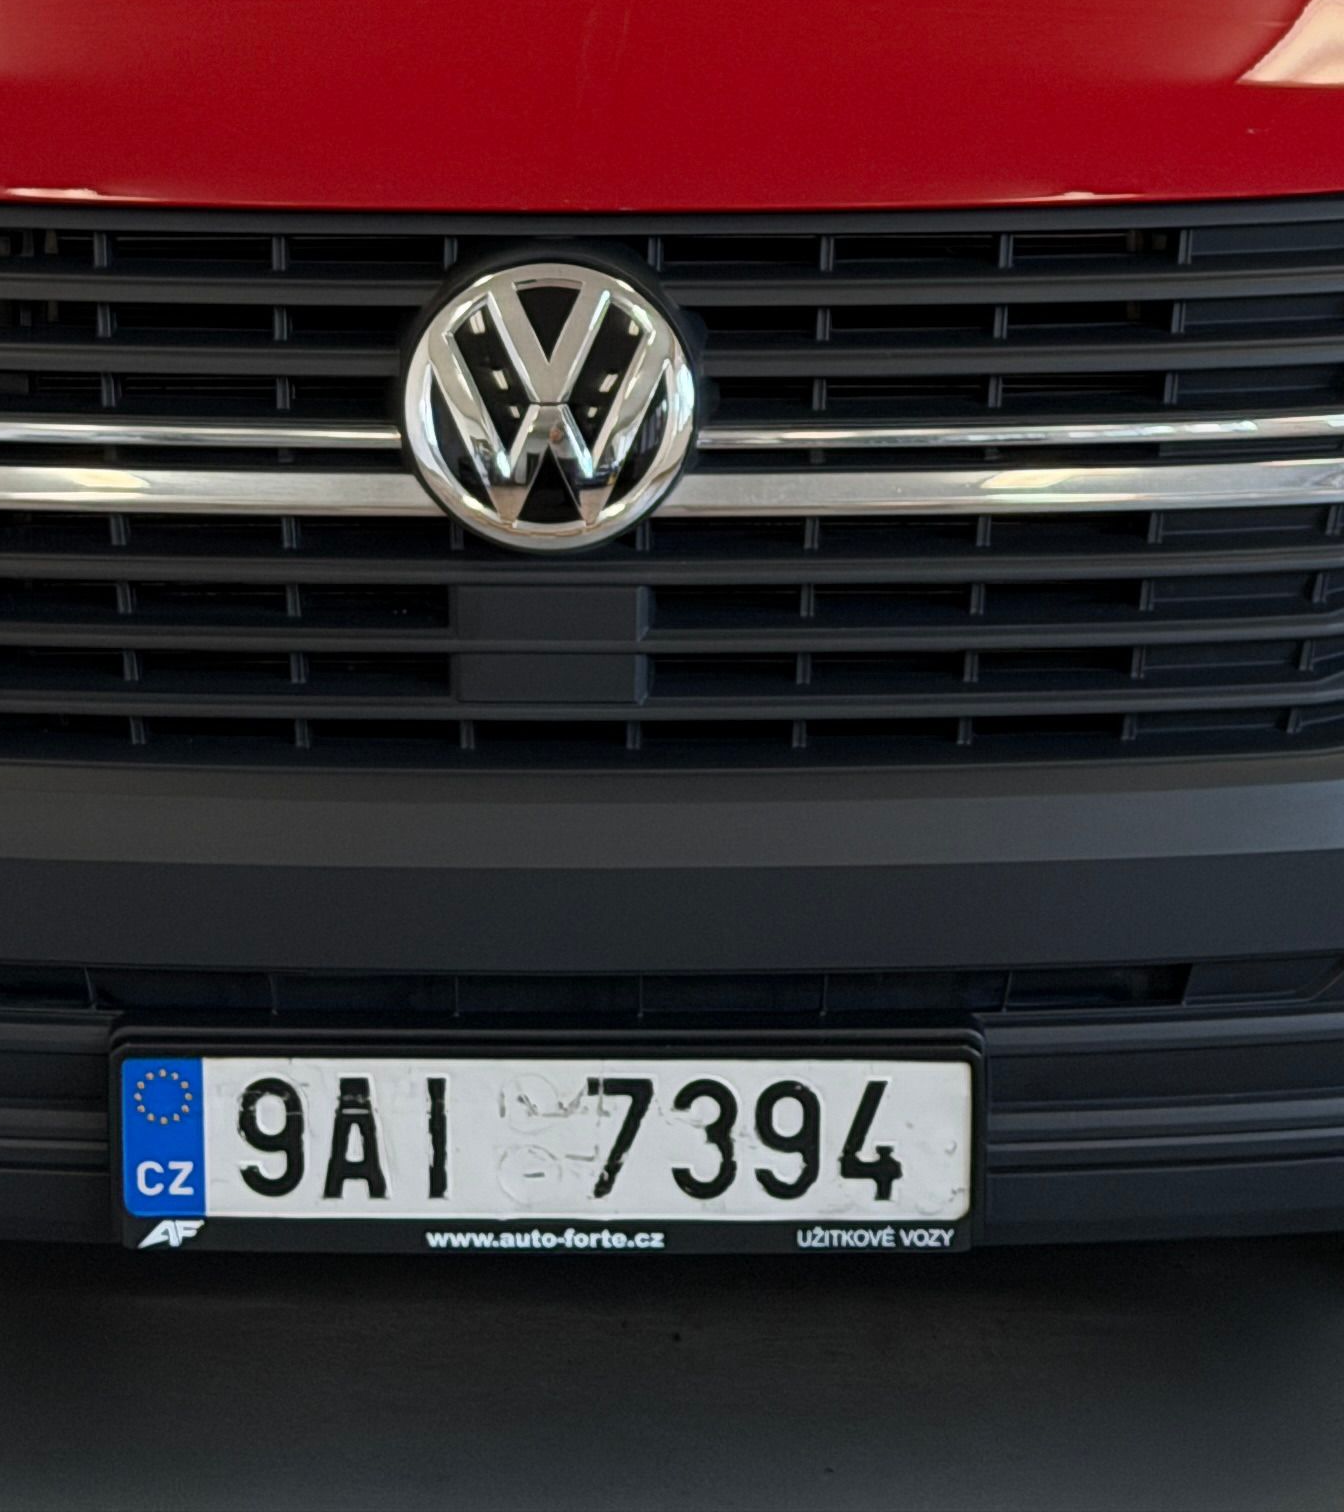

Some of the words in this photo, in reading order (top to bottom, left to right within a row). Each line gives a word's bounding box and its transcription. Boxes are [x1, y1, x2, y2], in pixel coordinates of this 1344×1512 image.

[587, 1078, 903, 1201] 7394
[136, 1161, 194, 1196] CZ
[426, 1228, 665, 1249] www.auto-forte.cz
[797, 1226, 896, 1248] UŽITKOVÉ
[900, 1228, 954, 1248] VOZY
